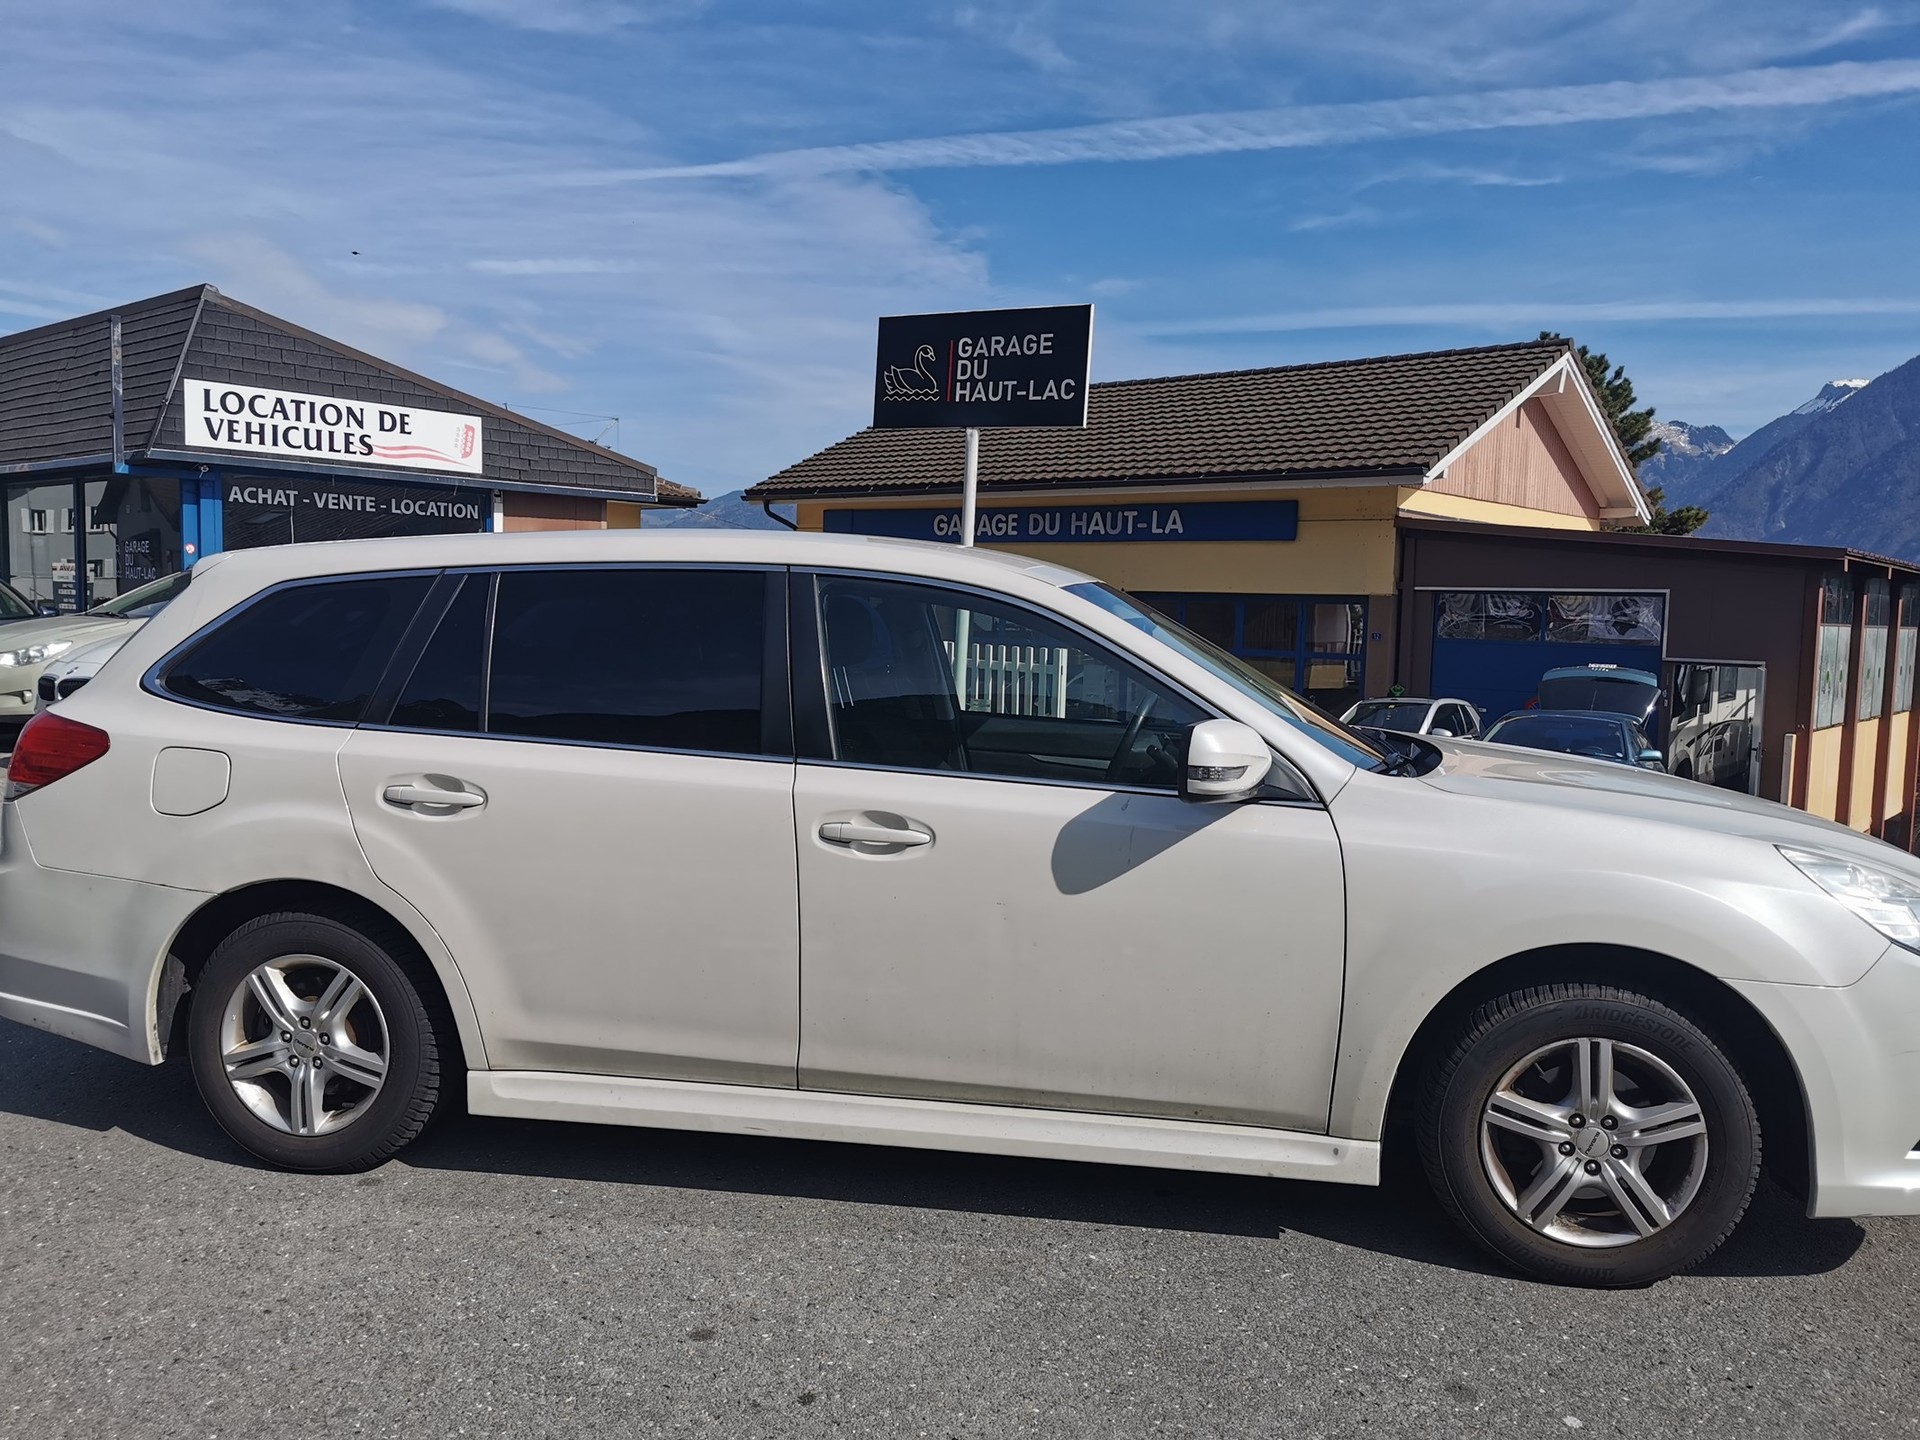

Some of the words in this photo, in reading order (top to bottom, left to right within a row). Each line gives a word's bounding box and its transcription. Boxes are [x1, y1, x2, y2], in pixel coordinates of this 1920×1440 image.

[957, 333, 1054, 358] GARAGE
[956, 359, 988, 380] DU
[955, 379, 1076, 402] HAUT-LAC
[203, 388, 364, 430] LOCATION
[378, 409, 412, 435] DE
[203, 416, 374, 456] VEHICULES
[228, 485, 298, 507] ACHAT
[313, 491, 376, 512] VENTE
[391, 498, 478, 519] LOCATION
[933, 513, 1018, 536] GAAGE
[1028, 512, 1060, 535] DU
[1070, 509, 1183, 535] HAUT-LA
[124, 540, 150, 553] GARAGE
[124, 553, 134, 566] DU
[125, 566, 157, 580] HAUT-LAC
[1576, 1005, 1695, 1054] BRIDGESTONE
